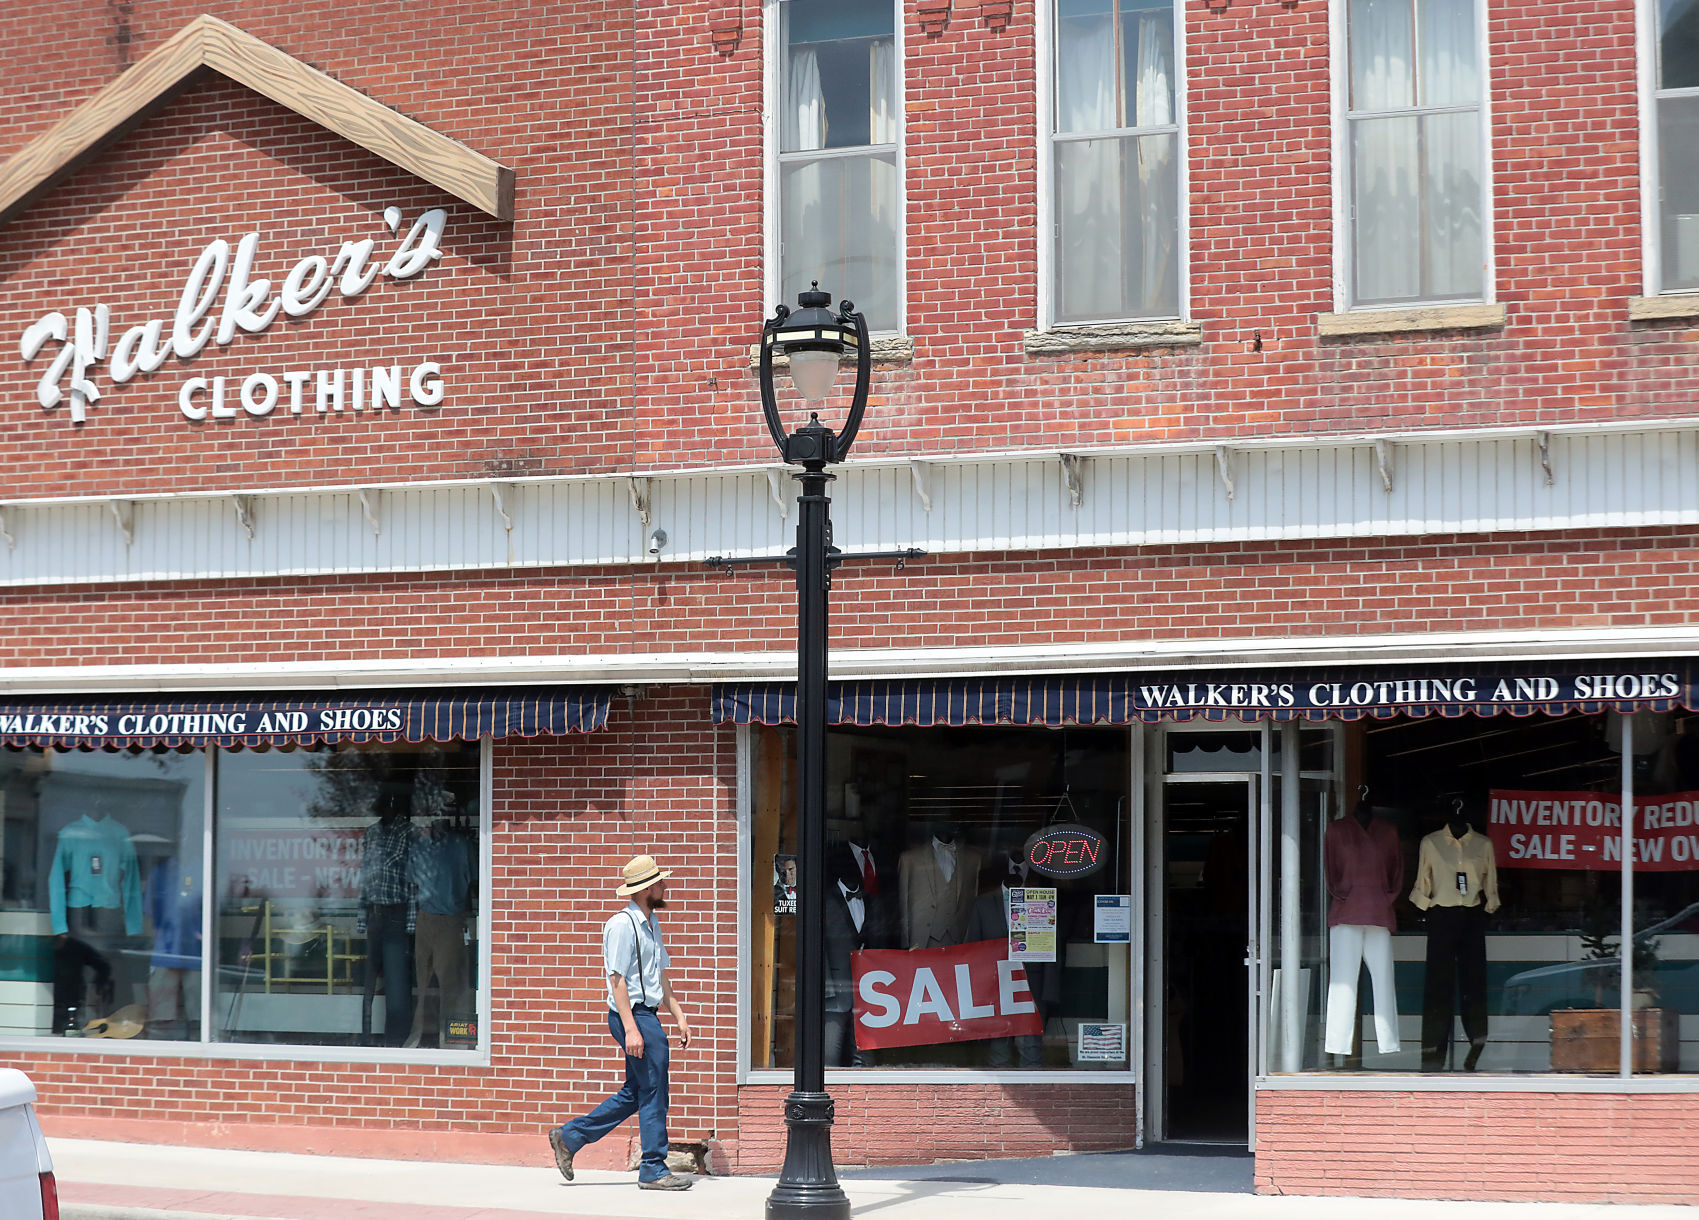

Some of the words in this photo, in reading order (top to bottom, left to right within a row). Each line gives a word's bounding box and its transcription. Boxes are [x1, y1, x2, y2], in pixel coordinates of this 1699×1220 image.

[178, 361, 445, 420] CLOTHING
[1140, 683, 1294, 707] WALKER'S
[1308, 678, 1478, 707] CLOTHING
[1490, 676, 1560, 701] AND
[1574, 673, 1680, 700] SHOES
[118, 713, 247, 735] CLOTHING
[255, 711, 309, 733] AND
[320, 708, 401, 731] SHOES
[231, 838, 342, 860] INVENTORY
[1030, 840, 1101, 864] OPEN
[1508, 833, 1576, 860] SALE
[247, 867, 297, 889] SALE
[315, 867, 361, 889] NEW
[859, 960, 1036, 1028] SALE
